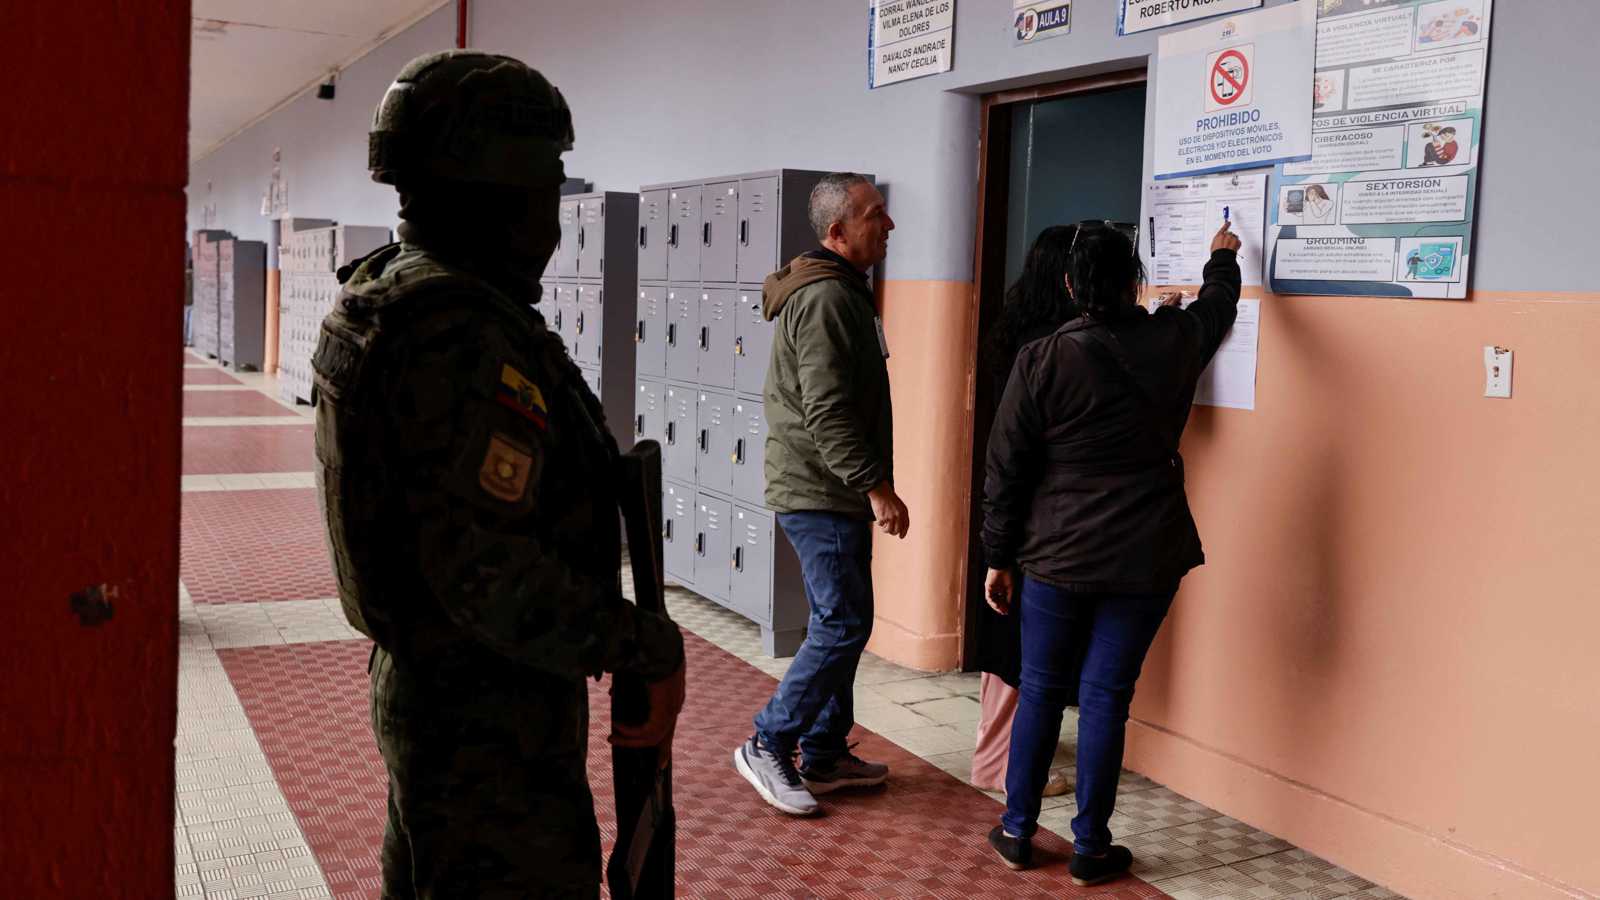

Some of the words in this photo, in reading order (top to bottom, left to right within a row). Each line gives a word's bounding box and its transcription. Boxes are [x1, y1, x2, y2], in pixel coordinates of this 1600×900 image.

[879, 3, 904, 18] CORRAL
[882, 16, 901, 30] VILMA
[902, 10, 923, 24] ELENA
[925, 6, 934, 18] DE
[935, 1, 949, 15] LOS
[1039, 10, 1061, 28] AULA
[1061, 7, 1067, 22] 9
[1140, 0, 1189, 18] ROBERTO
[899, 20, 930, 38] DOLORES
[882, 48, 912, 64] DAVALOS
[913, 39, 946, 55] ANDRADE
[887, 61, 910, 74] NANCY
[910, 54, 937, 69] CECILIA
[1196, 109, 1260, 132] PROHIBIDO
[1333, 116, 1347, 126] DE
[1349, 112, 1409, 124] VIOLENCIA
[1411, 105, 1463, 118] VIRTUAL
[1179, 137, 1193, 146] USO
[1193, 135, 1201, 143] DE
[1203, 127, 1246, 142] DISPOSITIVOS
[1314, 131, 1374, 144] CIBERACOSO
[1186, 156, 1194, 166] EN
[1196, 155, 1203, 163] EL
[1204, 150, 1236, 162] MOMENTO
[1237, 147, 1250, 157] DEL
[1252, 144, 1273, 155] VOTO
[1366, 179, 1441, 191] SEXTORSIÓN
